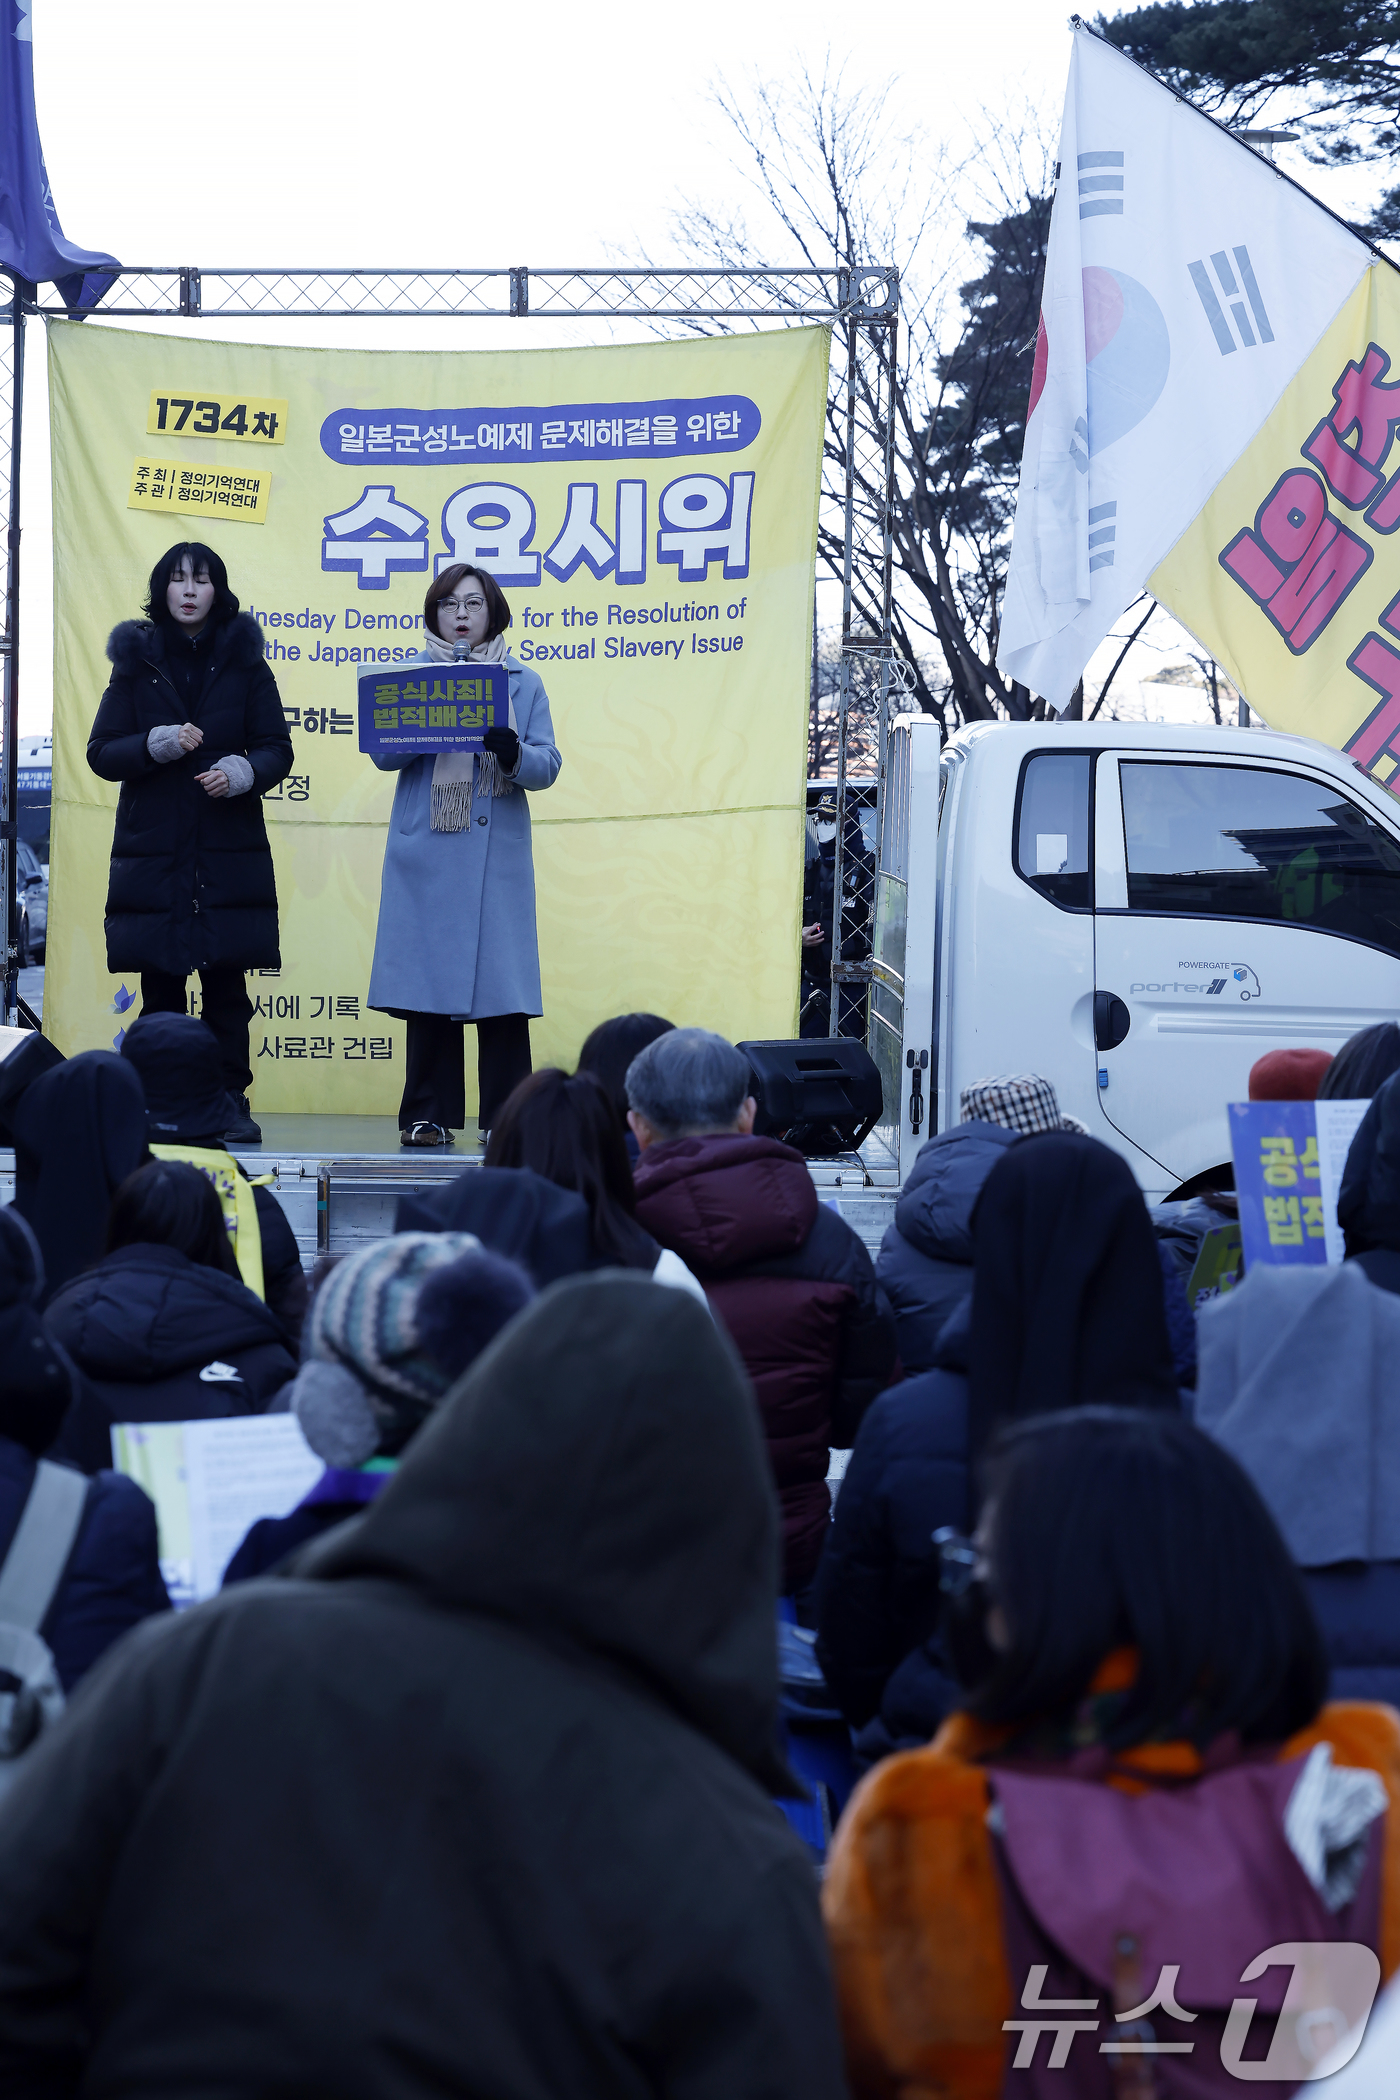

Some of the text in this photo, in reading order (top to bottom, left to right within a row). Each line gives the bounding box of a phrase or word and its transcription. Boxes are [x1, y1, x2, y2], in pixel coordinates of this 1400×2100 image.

[156, 397, 279, 439] 1734차
[338, 410, 742, 454] 일본군성노예제 문제해결을 위한
[180, 471, 260, 493] 정의기억연대
[178, 487, 258, 509] 정의기억연대
[321, 470, 756, 590] 수요시위
[522, 607, 554, 628] for
[561, 606, 599, 627] the
[607, 600, 719, 625] Resolution
[726, 597, 747, 619] of
[265, 639, 301, 661] the
[308, 641, 419, 667] Japanese
[519, 638, 596, 661] Sexual
[604, 637, 684, 659] Slavery
[691, 633, 744, 654] Issue
[374, 679, 494, 705] 공식사죄!
[373, 705, 495, 729] 법적배상!
[1178, 961, 1230, 969] POWERGATE
[310, 996, 361, 1020] 기록
[257, 1036, 393, 1060] 사료관 건립
